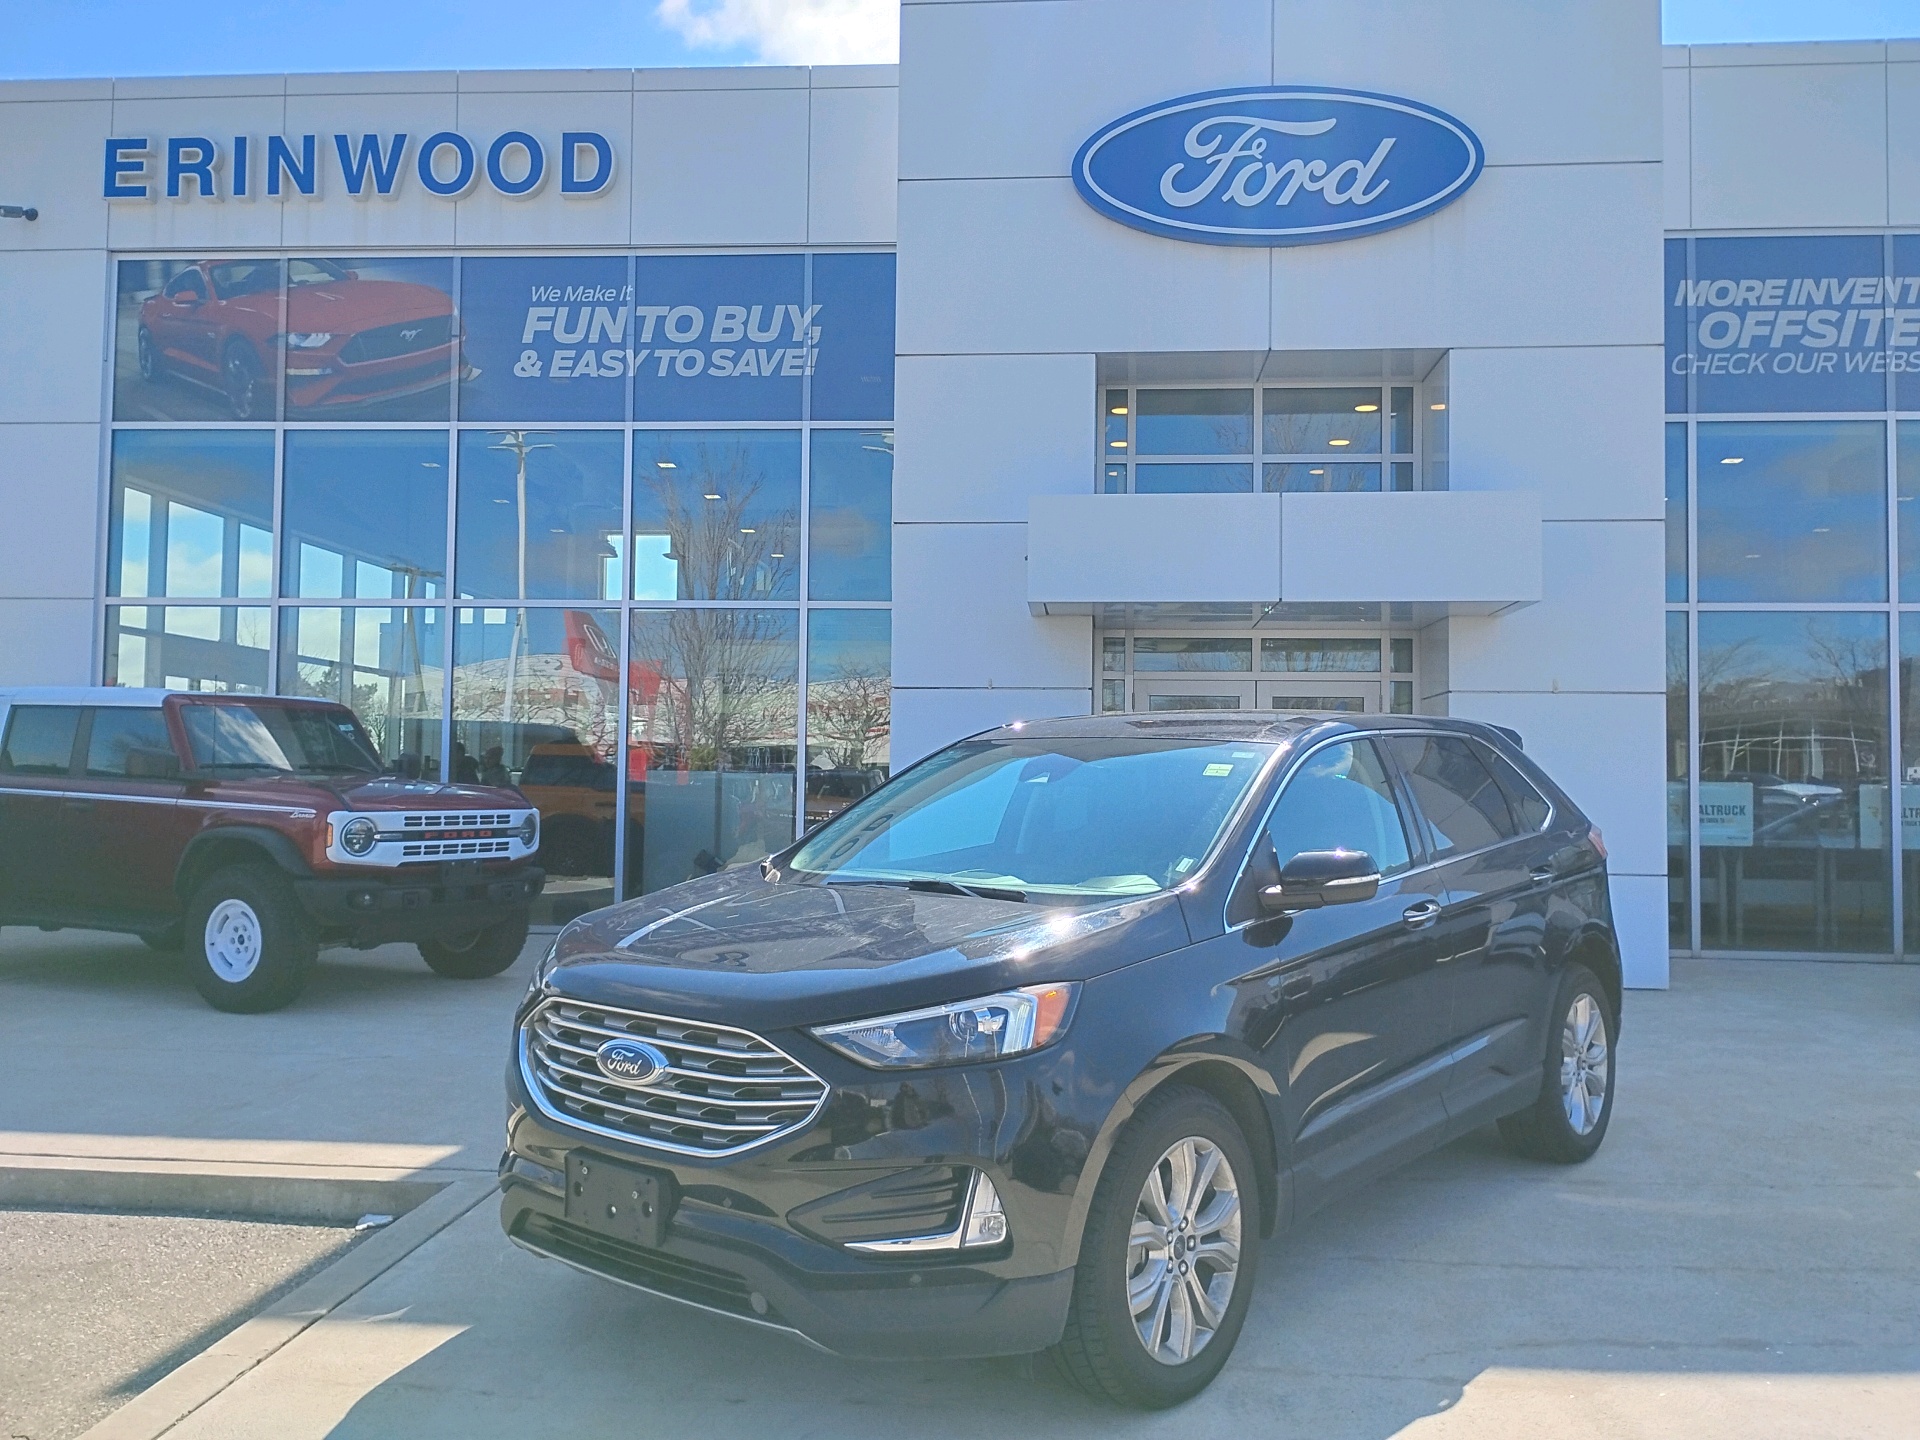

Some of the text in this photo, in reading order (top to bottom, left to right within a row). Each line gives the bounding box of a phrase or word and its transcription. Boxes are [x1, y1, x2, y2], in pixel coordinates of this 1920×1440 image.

[103, 130, 617, 201] ERINWOOD
[1159, 115, 1397, 208] Ford
[531, 285, 634, 302] We Make It
[1673, 276, 1920, 307] MORE INVENT
[521, 304, 824, 346] FUN TO BUY,
[1698, 308, 1920, 350] OFFSITE
[513, 347, 820, 378] & EASY TO SAVE!
[1671, 352, 1769, 375] CHECK
[1772, 352, 1838, 375] OUR
[1699, 804, 1747, 816] ALTRUCK
[424, 830, 493, 839] FORD
[607, 1048, 643, 1075] Ford
